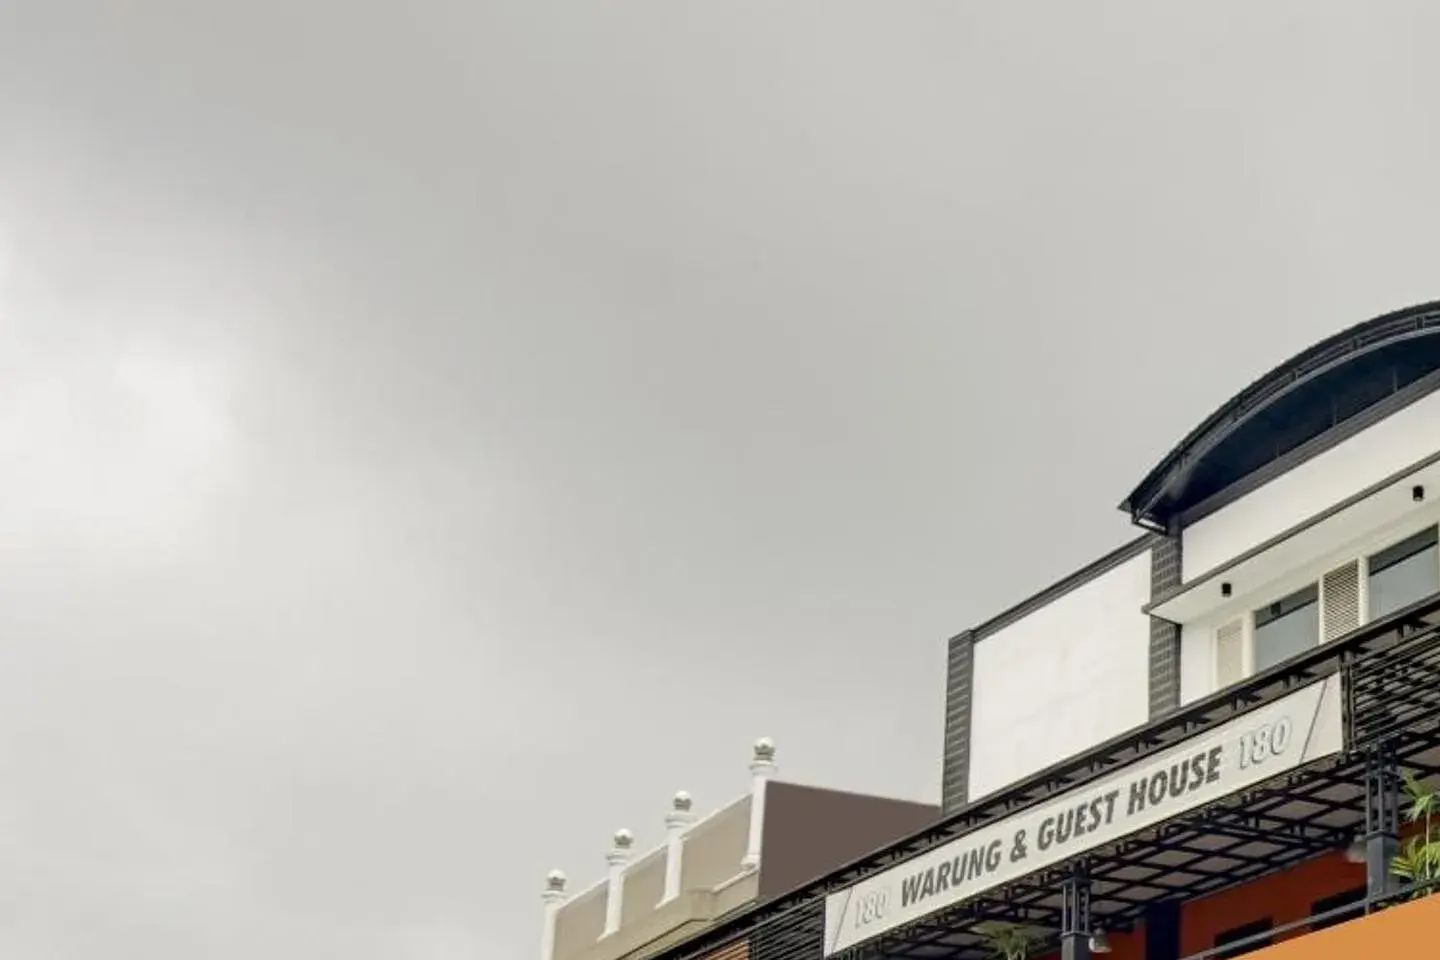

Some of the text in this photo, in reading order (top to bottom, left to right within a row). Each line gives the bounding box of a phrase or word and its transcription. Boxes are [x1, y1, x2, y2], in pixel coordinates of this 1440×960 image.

[901, 839, 1003, 907] WARUNG
[1009, 829, 1028, 862] &
[1037, 790, 1120, 851] GUEST
[1126, 745, 1223, 816] HOUSE
[1238, 714, 1293, 770] 180
